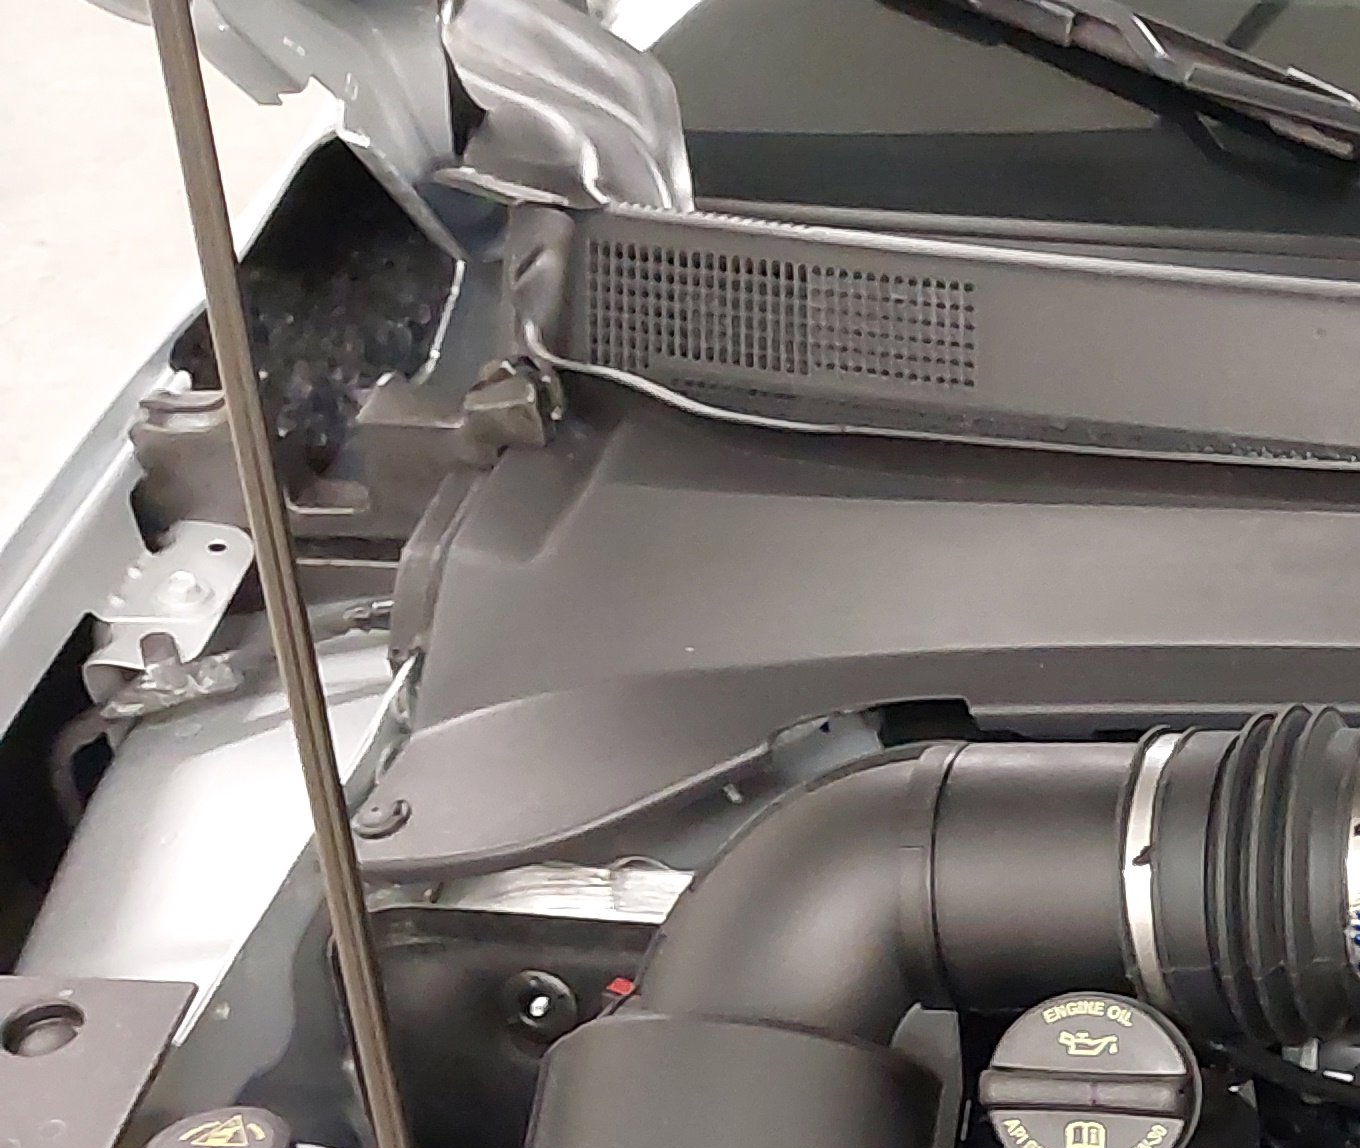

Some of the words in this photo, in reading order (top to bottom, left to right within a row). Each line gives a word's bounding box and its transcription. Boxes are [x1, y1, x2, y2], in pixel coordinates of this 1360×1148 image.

[1043, 1001, 1105, 1023] ENGINE
[1107, 1005, 1133, 1027] OIL
[1003, 1118, 1029, 1145] API
